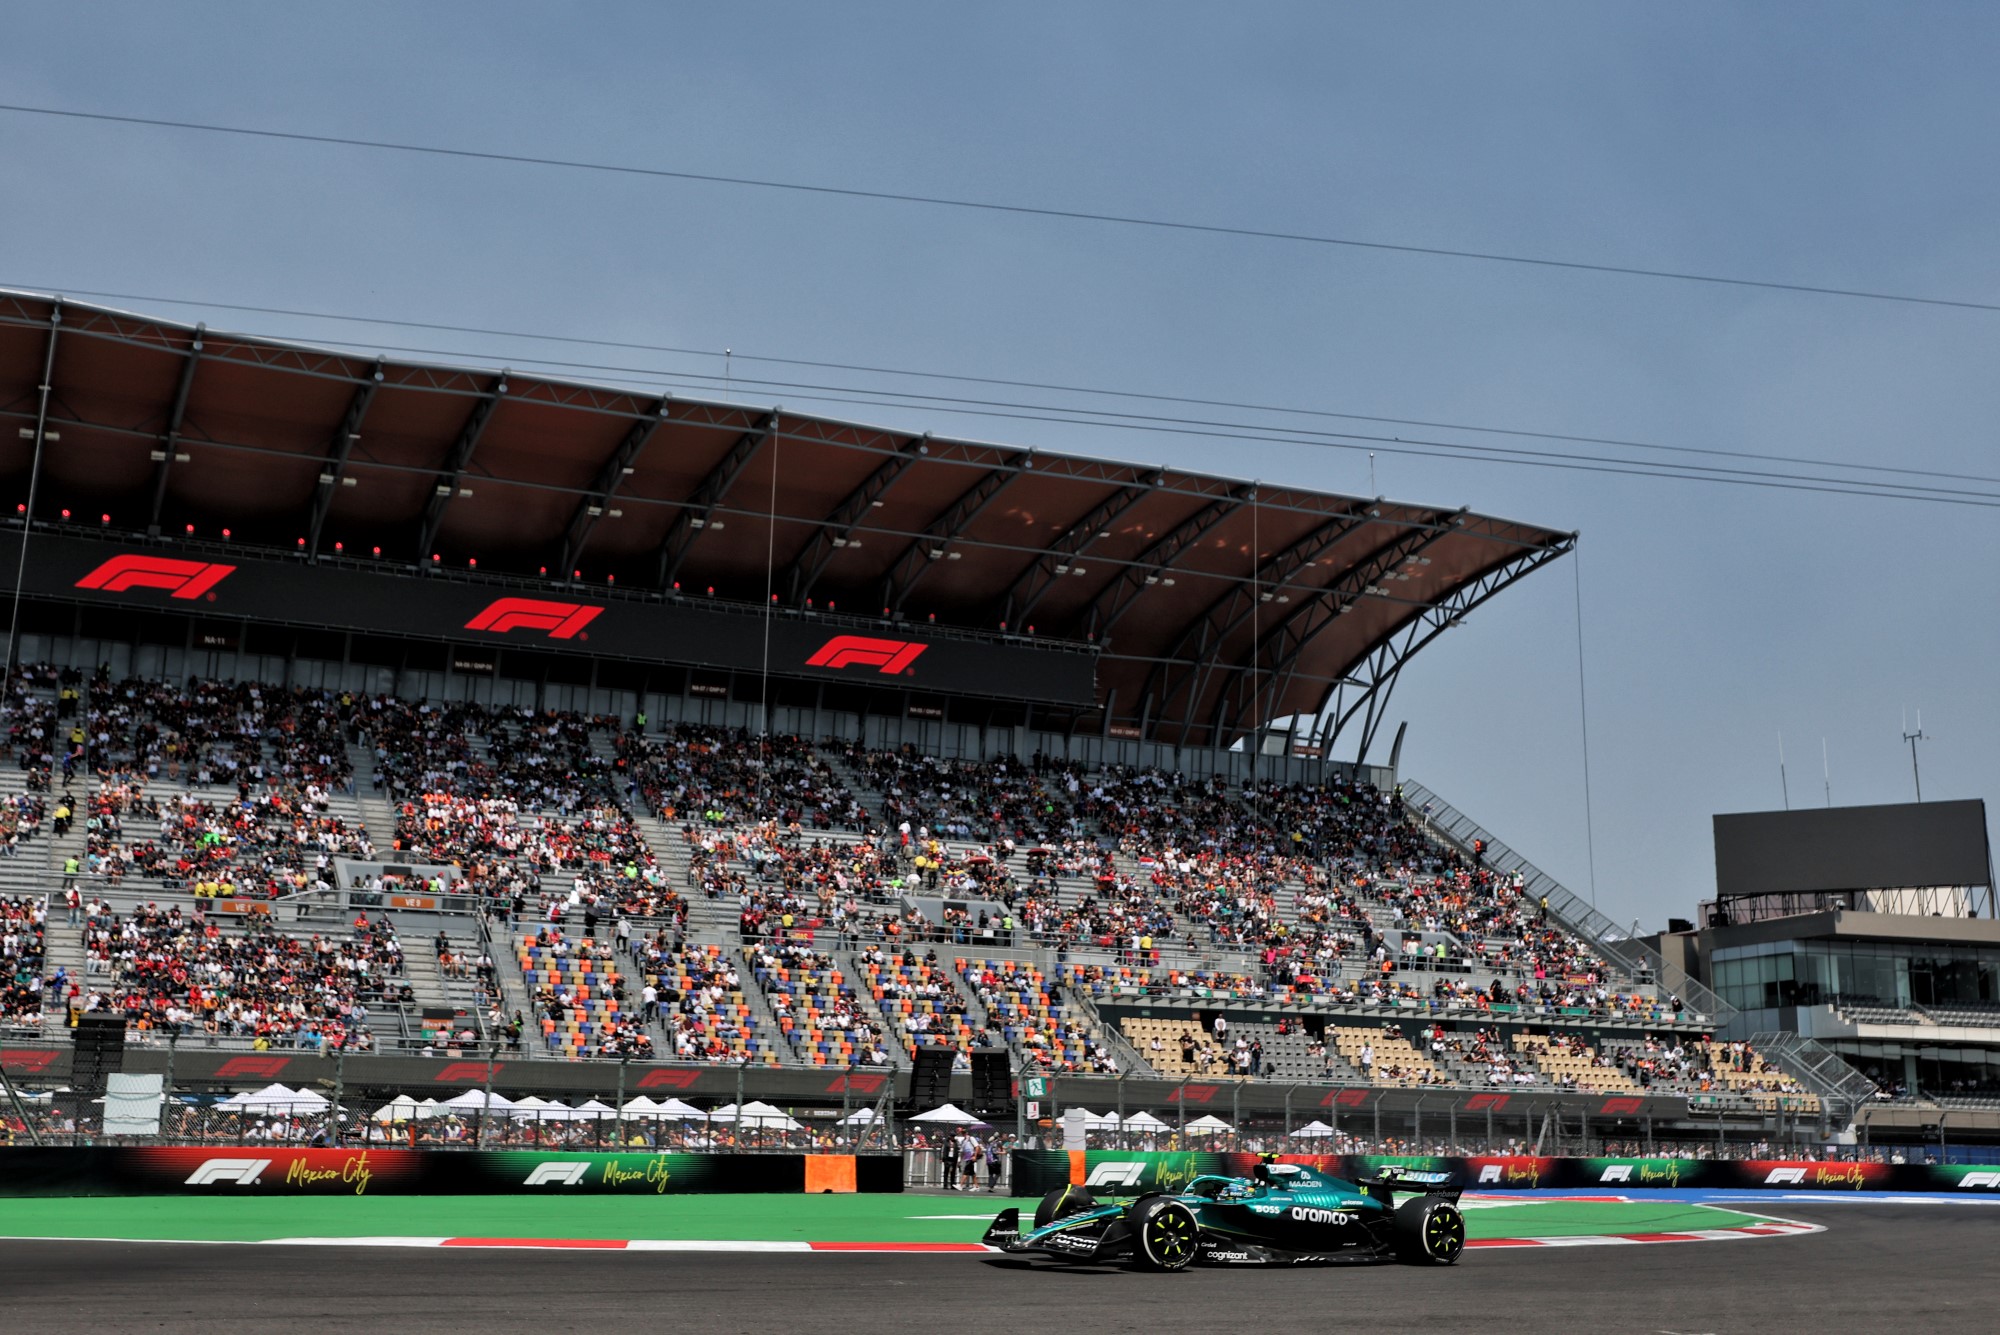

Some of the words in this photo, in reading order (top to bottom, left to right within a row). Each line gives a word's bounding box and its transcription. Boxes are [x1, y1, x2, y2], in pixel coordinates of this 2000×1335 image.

[74, 554, 237, 599] F1
[464, 597, 605, 639] F1
[805, 635, 928, 674] F1
[235, 903, 246, 912] VE
[405, 898, 415, 906] VE
[213, 1057, 290, 1077] F1
[636, 1069, 701, 1088] F1
[1600, 1098, 1643, 1114] F1
[184, 1158, 272, 1185] F1
[286, 1157, 340, 1187] Mexico
[342, 1150, 373, 1195] City
[522, 1162, 592, 1185] F1
[602, 1160, 646, 1187] Mexico
[646, 1154, 670, 1194] City
[1084, 1162, 1147, 1186] F1
[1155, 1160, 1184, 1187] Mexico
[1478, 1165, 1503, 1183] F1
[1507, 1164, 1528, 1183] Mexico
[1527, 1159, 1539, 1188] City
[1599, 1165, 1634, 1182] F1
[1640, 1164, 1665, 1183] Mexico
[1665, 1160, 1679, 1188] City
[1764, 1167, 1808, 1184] F1
[1816, 1167, 1847, 1185] Mexico
[1847, 1163, 1865, 1190] City
[1288, 1180, 1322, 1188] MAADEN
[1359, 1186, 1368, 1196] 14
[1255, 1205, 1280, 1214] BOSS
[1292, 1207, 1348, 1226] aramco
[1207, 1251, 1248, 1260] cognizant
